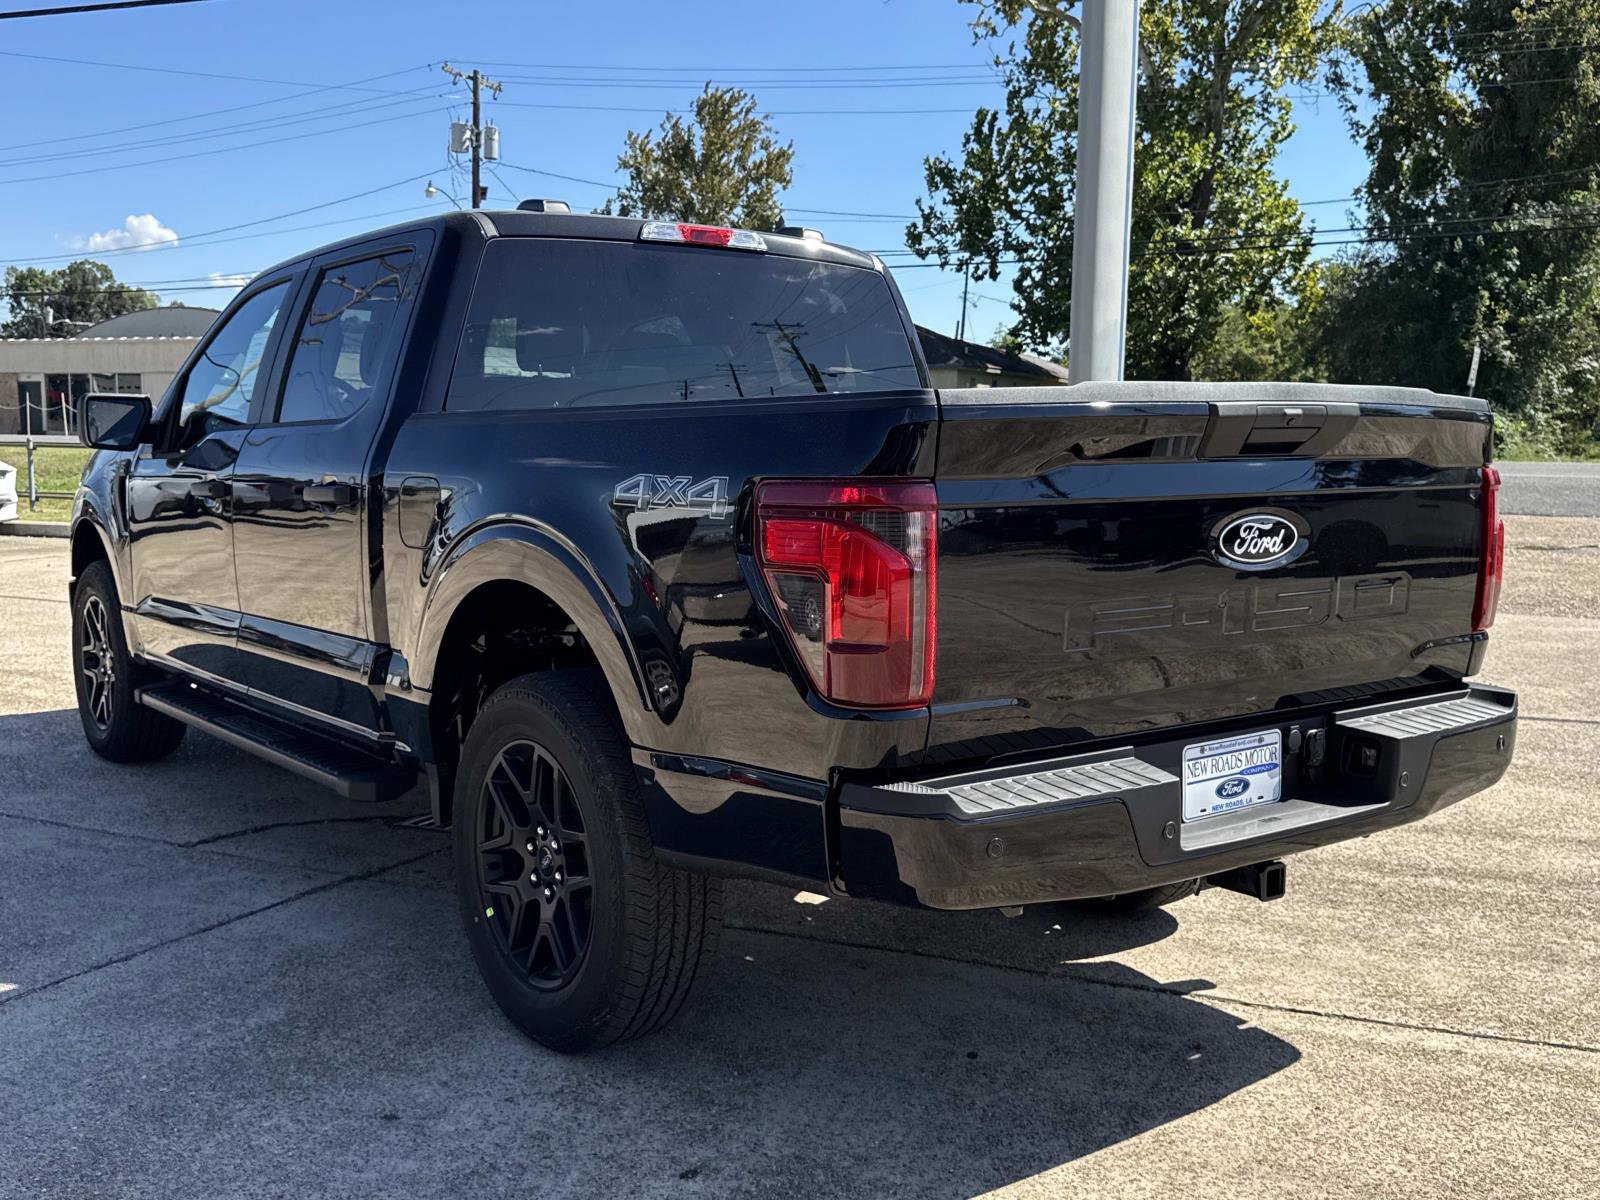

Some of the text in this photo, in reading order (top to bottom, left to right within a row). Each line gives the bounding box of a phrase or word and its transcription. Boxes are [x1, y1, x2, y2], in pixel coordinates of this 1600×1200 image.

[1233, 522, 1285, 555] Ford
[1063, 570, 1413, 652] F-150
[1208, 738, 1259, 752] NewRoadsFord.com
[1187, 747, 1278, 779] NEW ROADS MOTOR
[1242, 764, 1275, 775] COMPANY
[1221, 781, 1244, 796] Ford
[1211, 803, 1224, 812] NEW
